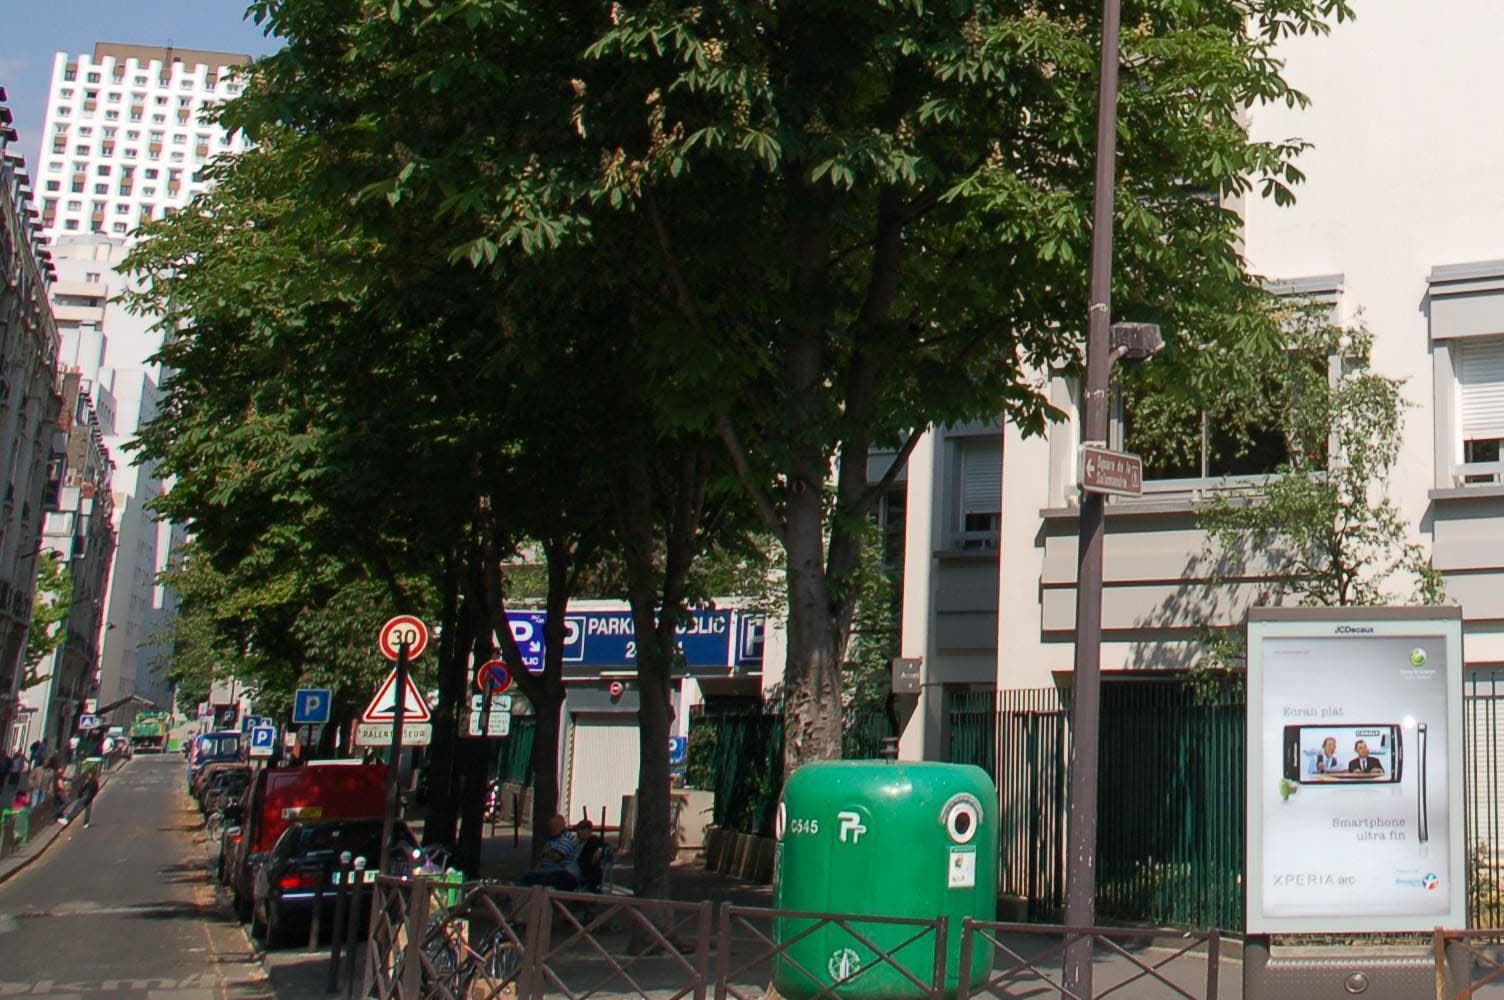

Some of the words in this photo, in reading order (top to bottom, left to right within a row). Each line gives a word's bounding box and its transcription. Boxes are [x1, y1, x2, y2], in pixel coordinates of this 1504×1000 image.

[1334, 625, 1374, 634] JCDecaux
[392, 629, 417, 646] 30
[304, 695, 320, 716] P
[257, 731, 268, 745] P
[1332, 816, 1406, 829] Smartphone
[1356, 830, 1386, 841] ultra
[1390, 829, 1406, 841] fin
[1273, 873, 1335, 887] XPERIA
